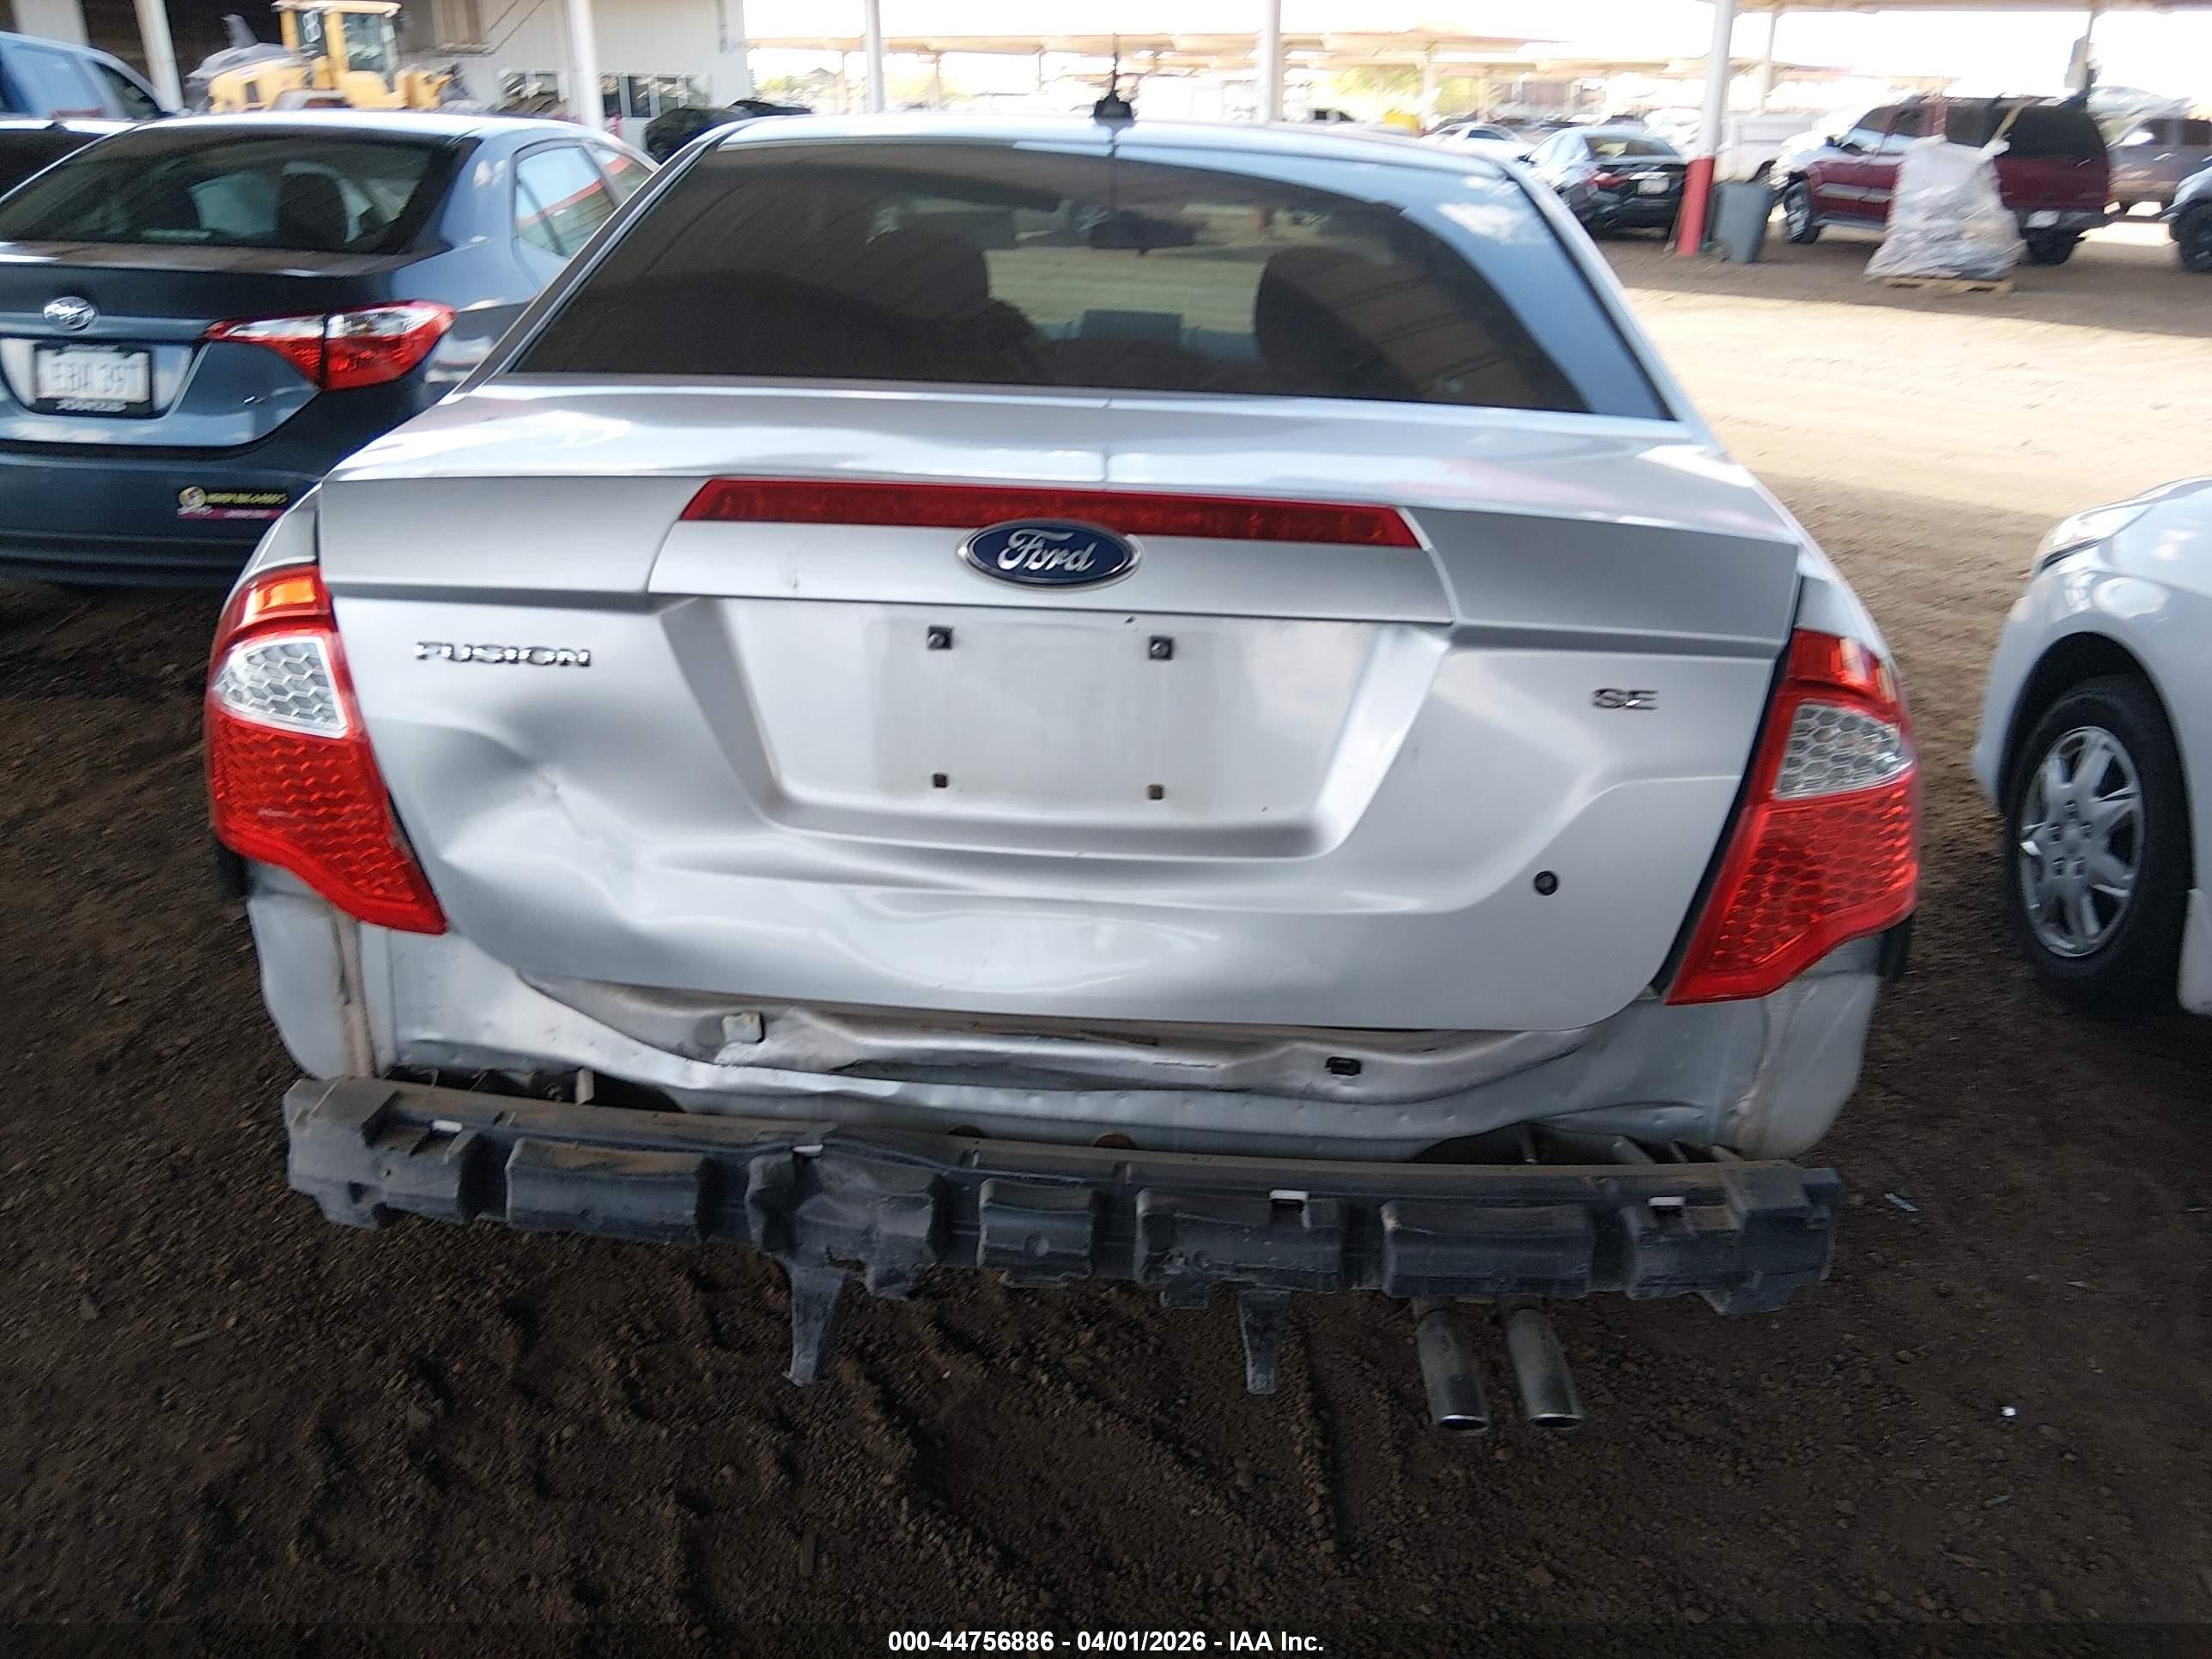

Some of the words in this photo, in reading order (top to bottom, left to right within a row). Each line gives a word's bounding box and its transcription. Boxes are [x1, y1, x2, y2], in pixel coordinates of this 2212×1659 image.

[996, 527, 1098, 573] Ford
[414, 641, 591, 667] FUSION
[1592, 688, 1659, 711] SE
